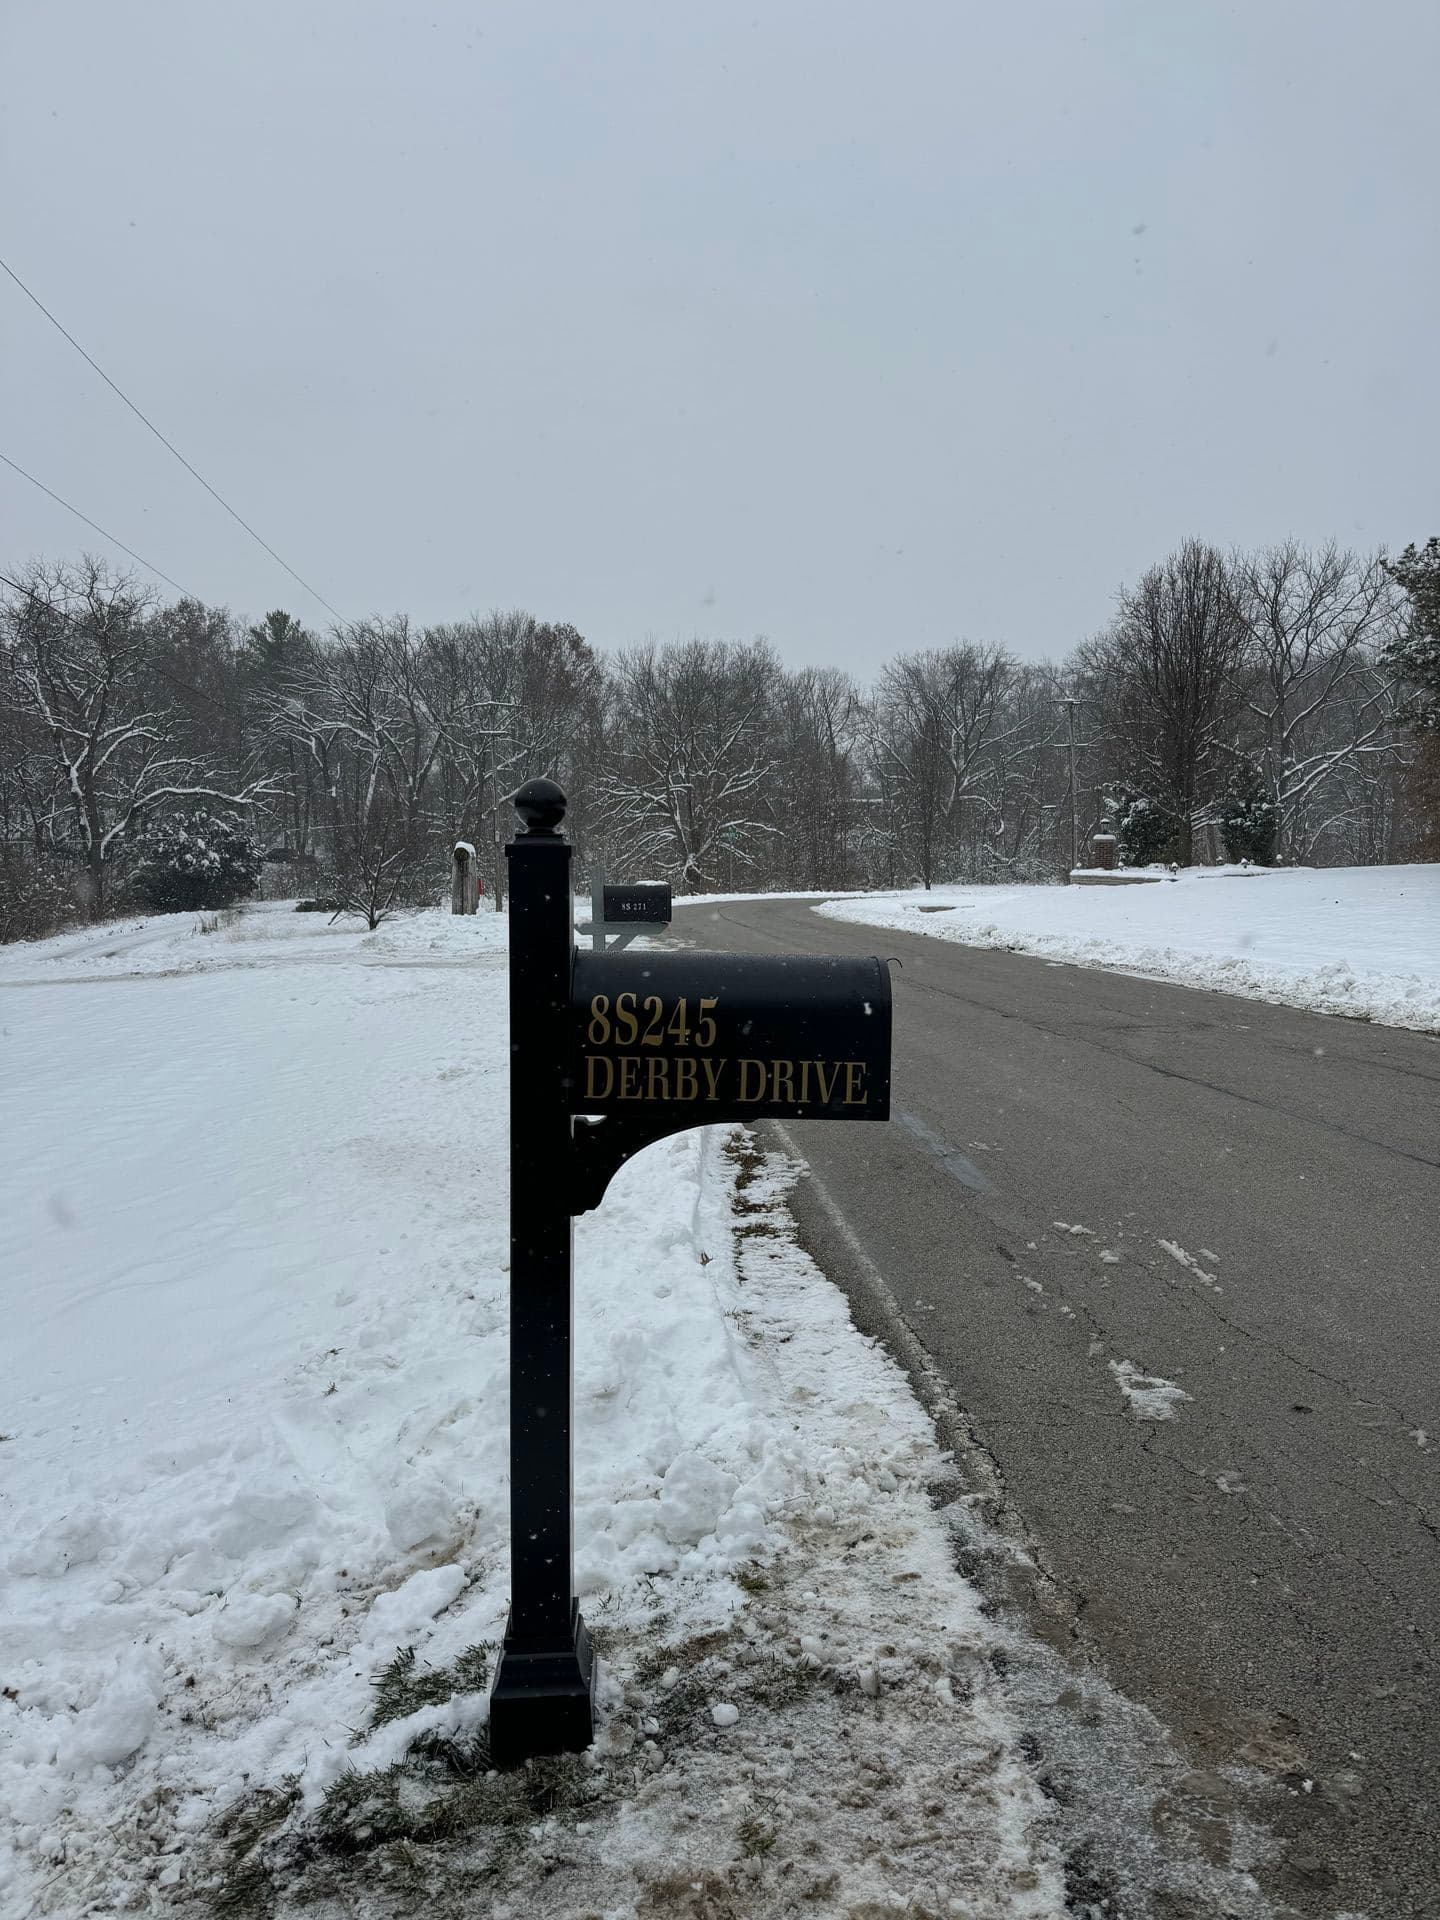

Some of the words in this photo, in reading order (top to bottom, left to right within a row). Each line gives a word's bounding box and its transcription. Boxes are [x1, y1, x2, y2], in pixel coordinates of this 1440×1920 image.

[587, 992, 719, 1048] 8S245
[583, 1055, 728, 1101] DERBY
[736, 1059, 869, 1105] DRIVE
